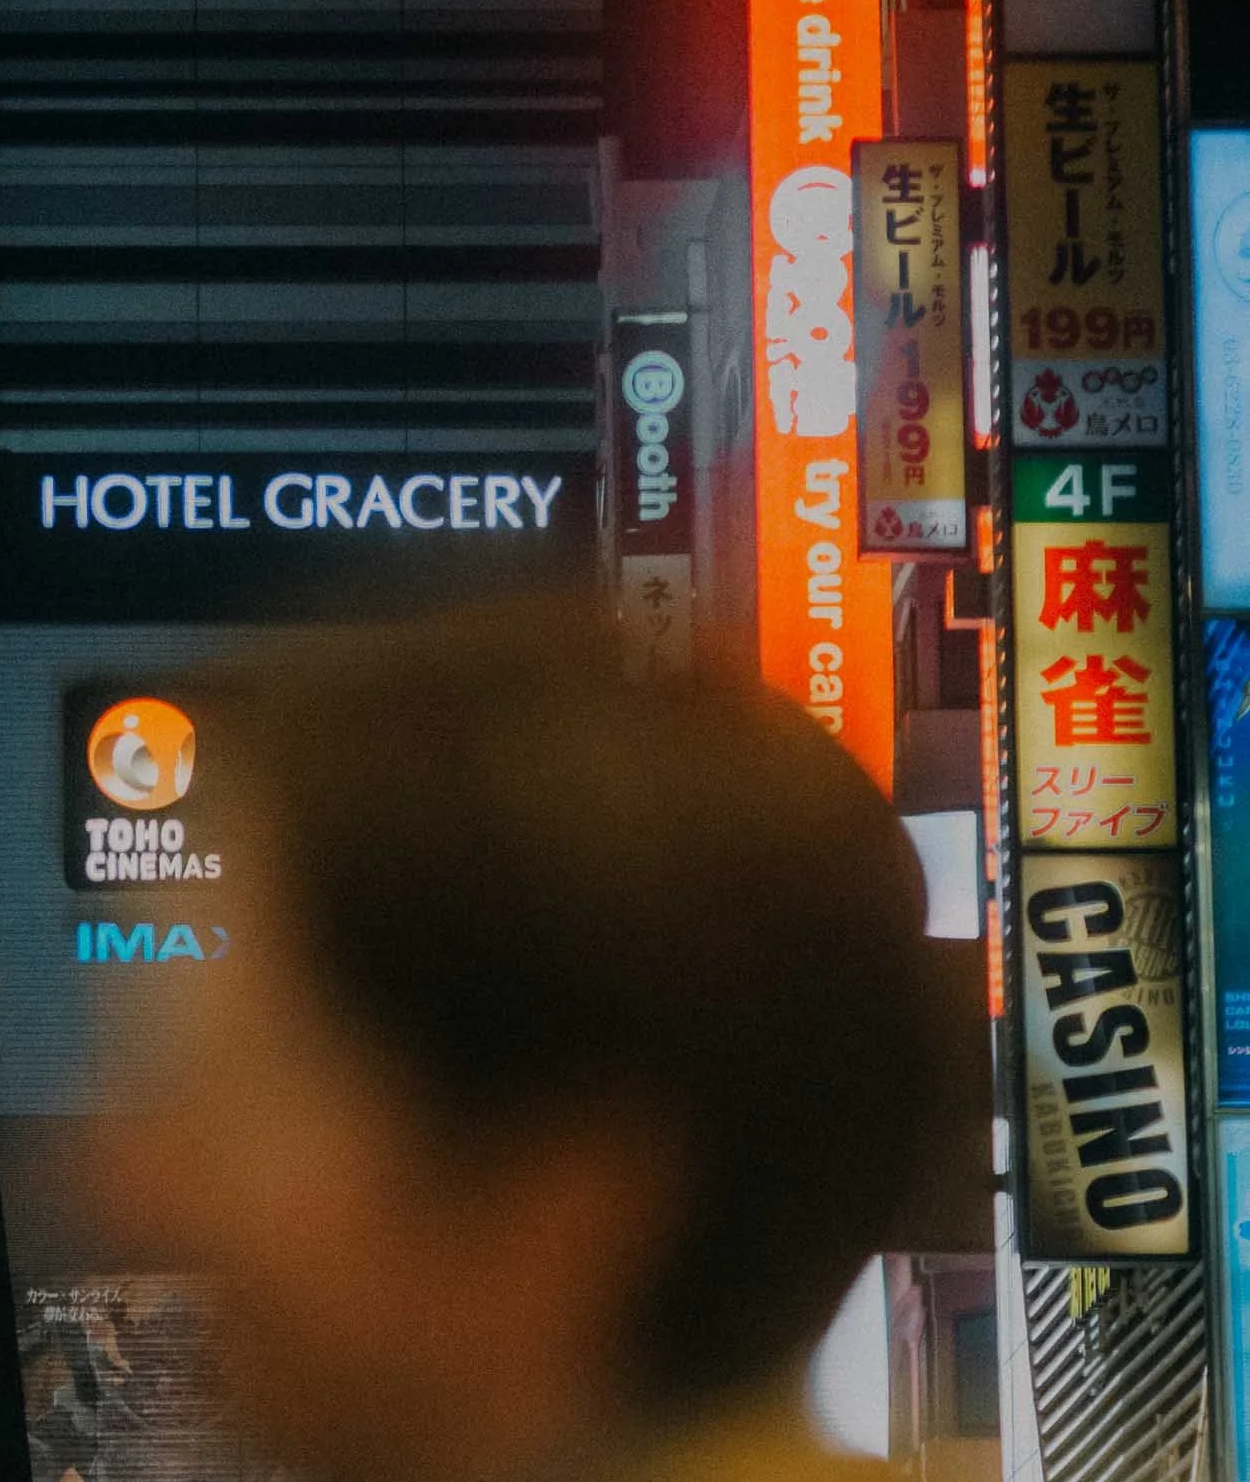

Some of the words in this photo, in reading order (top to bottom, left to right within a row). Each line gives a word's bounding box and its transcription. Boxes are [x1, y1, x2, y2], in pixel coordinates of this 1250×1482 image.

[796, 15, 843, 144] drink
[1044, 82, 1101, 286] 生ビール
[881, 163, 926, 329] 生ビール
[1020, 305, 1156, 352] 199円
[1086, 412, 1159, 437] 鳥メロ
[39, 473, 250, 530] HOTEL
[263, 472, 563, 530] GRACERY
[793, 458, 851, 535] try
[1045, 463, 1138, 516] 4F
[807, 542, 844, 629] our
[1038, 538, 1154, 748] 麻雀
[1034, 765, 1136, 796] スリー
[84, 818, 185, 853] TOHO
[1028, 801, 1170, 840] ファイブ
[84, 852, 223, 881] CINEMAS
[1027, 881, 1183, 1231] CASINO
